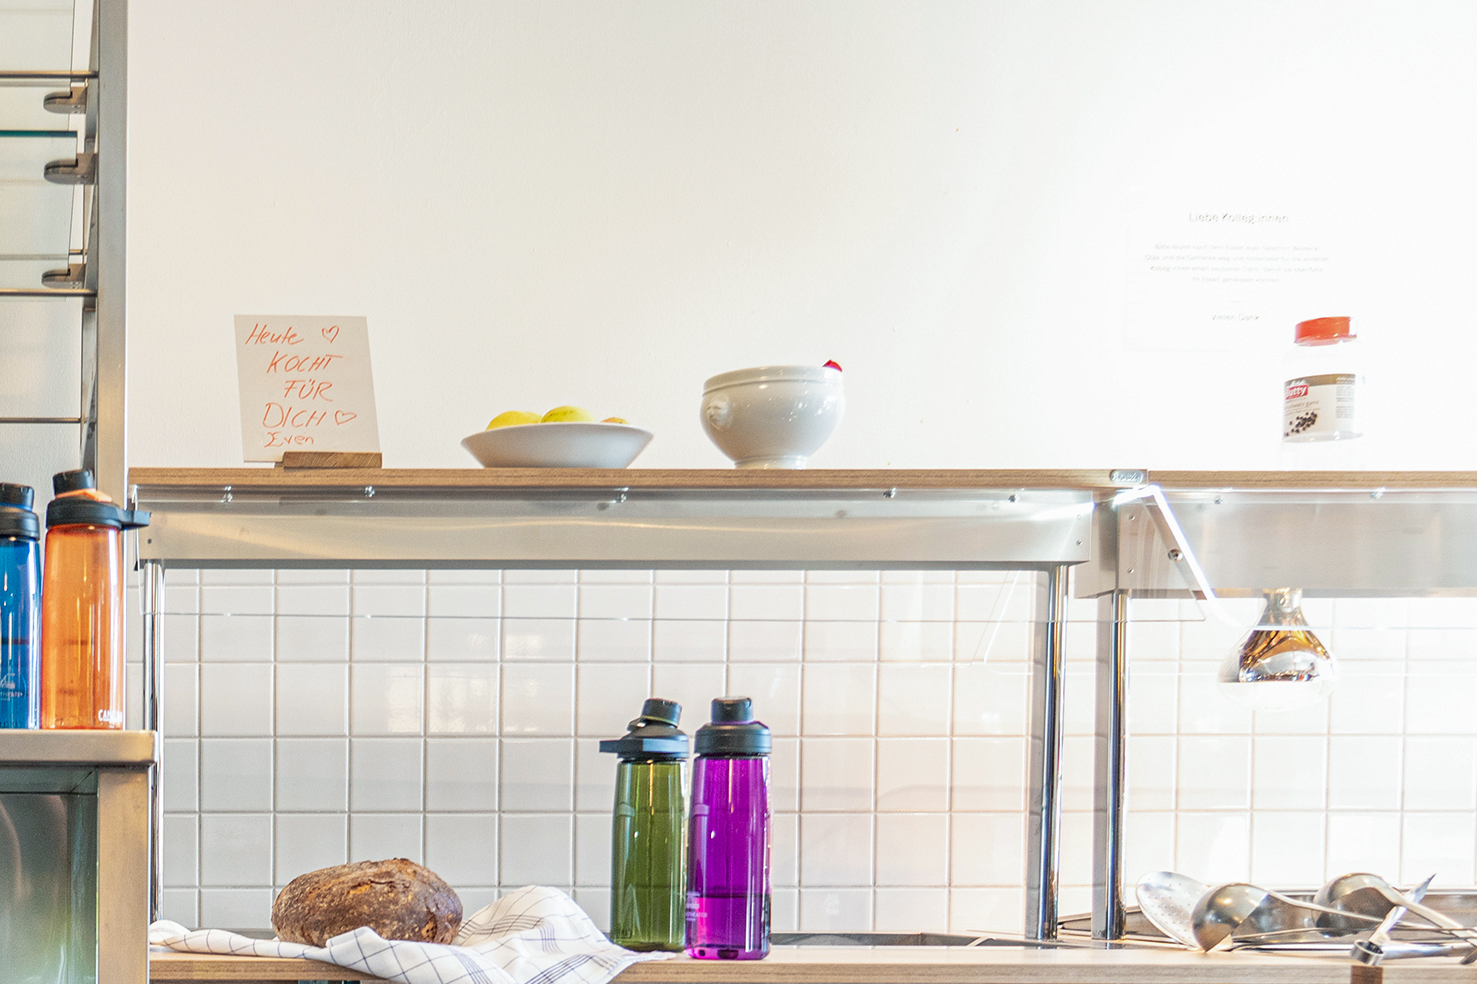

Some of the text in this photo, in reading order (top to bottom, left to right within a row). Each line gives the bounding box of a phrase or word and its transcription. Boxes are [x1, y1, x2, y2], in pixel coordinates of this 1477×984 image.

[1189, 213, 1220, 223] Liebe
[244, 323, 304, 345] Heute
[266, 350, 344, 374] KOCHT
[284, 379, 333, 402] FÜR
[262, 402, 327, 428] DICH
